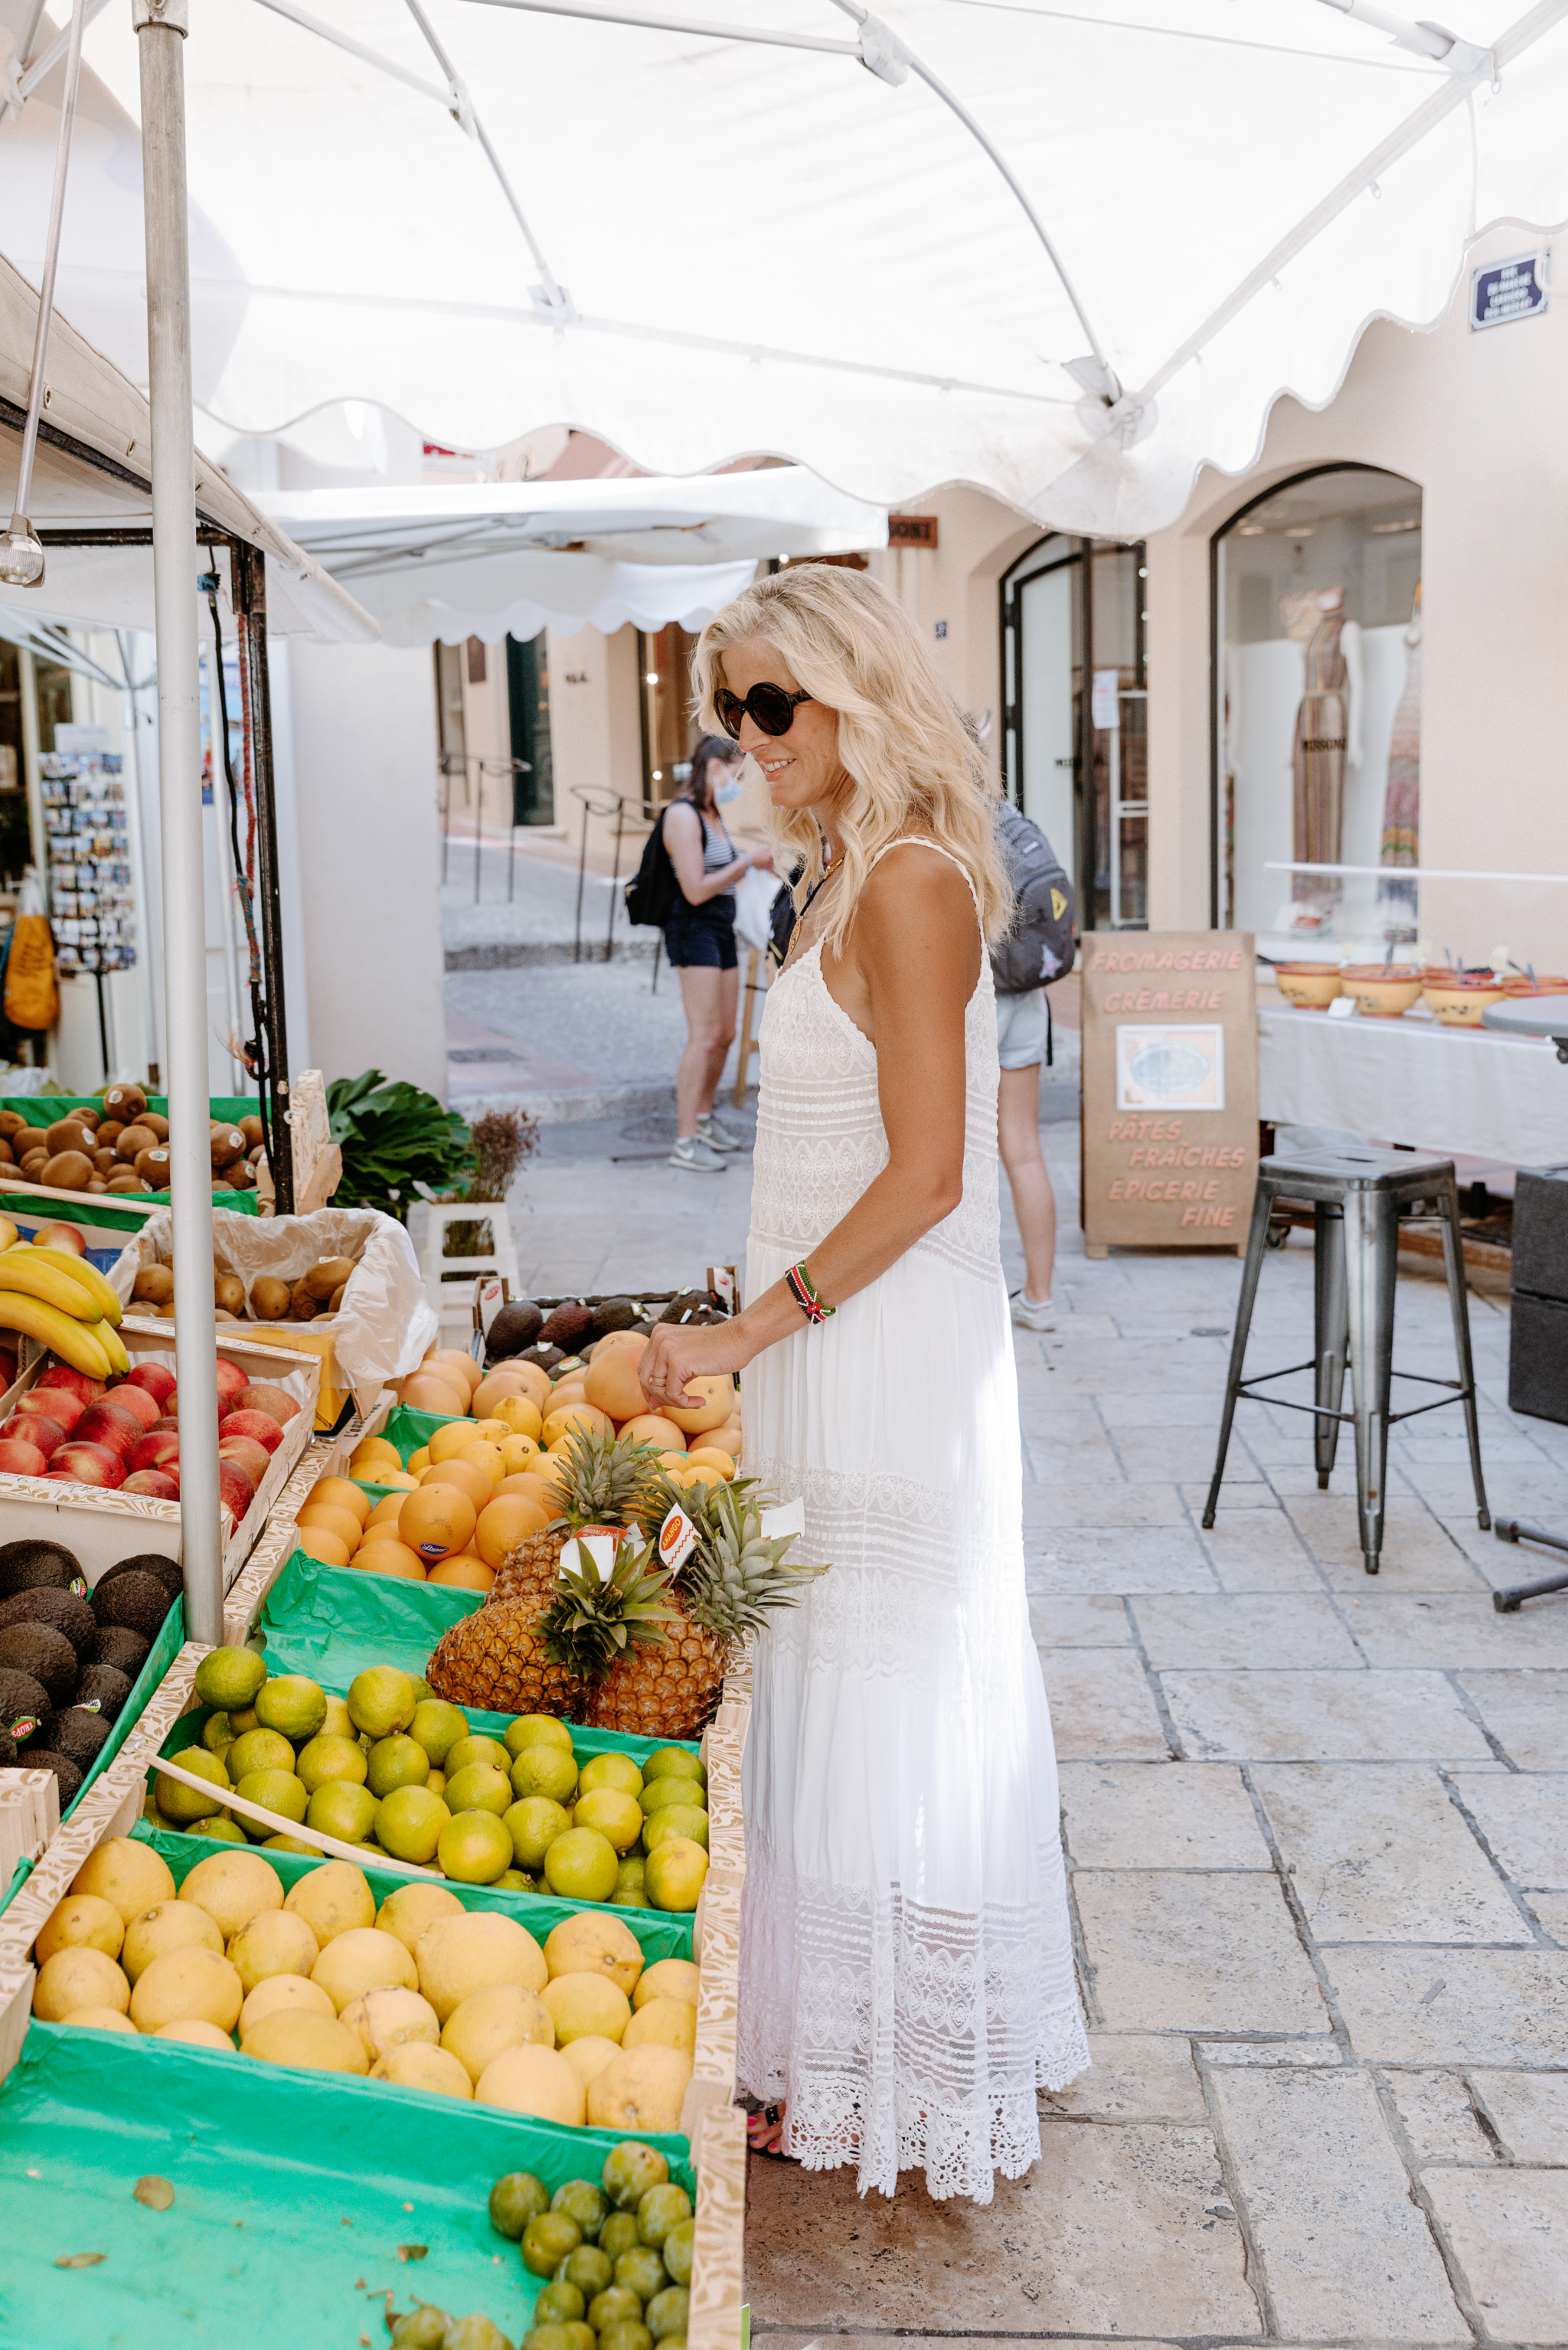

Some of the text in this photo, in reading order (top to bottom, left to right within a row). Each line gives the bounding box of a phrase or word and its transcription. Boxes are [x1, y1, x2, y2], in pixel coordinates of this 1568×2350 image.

[1090, 949, 1243, 973] FROMAGERIE
[1109, 1114, 1183, 1142] PÂTES
[1129, 1142, 1246, 1169] FRAÎCHES
[1109, 1175, 1220, 1201] ÉPICERIE
[1180, 1206, 1236, 1228] FINE
[662, 1518, 681, 1550] ANANGO
[11, 1721, 34, 1737] TROPS
